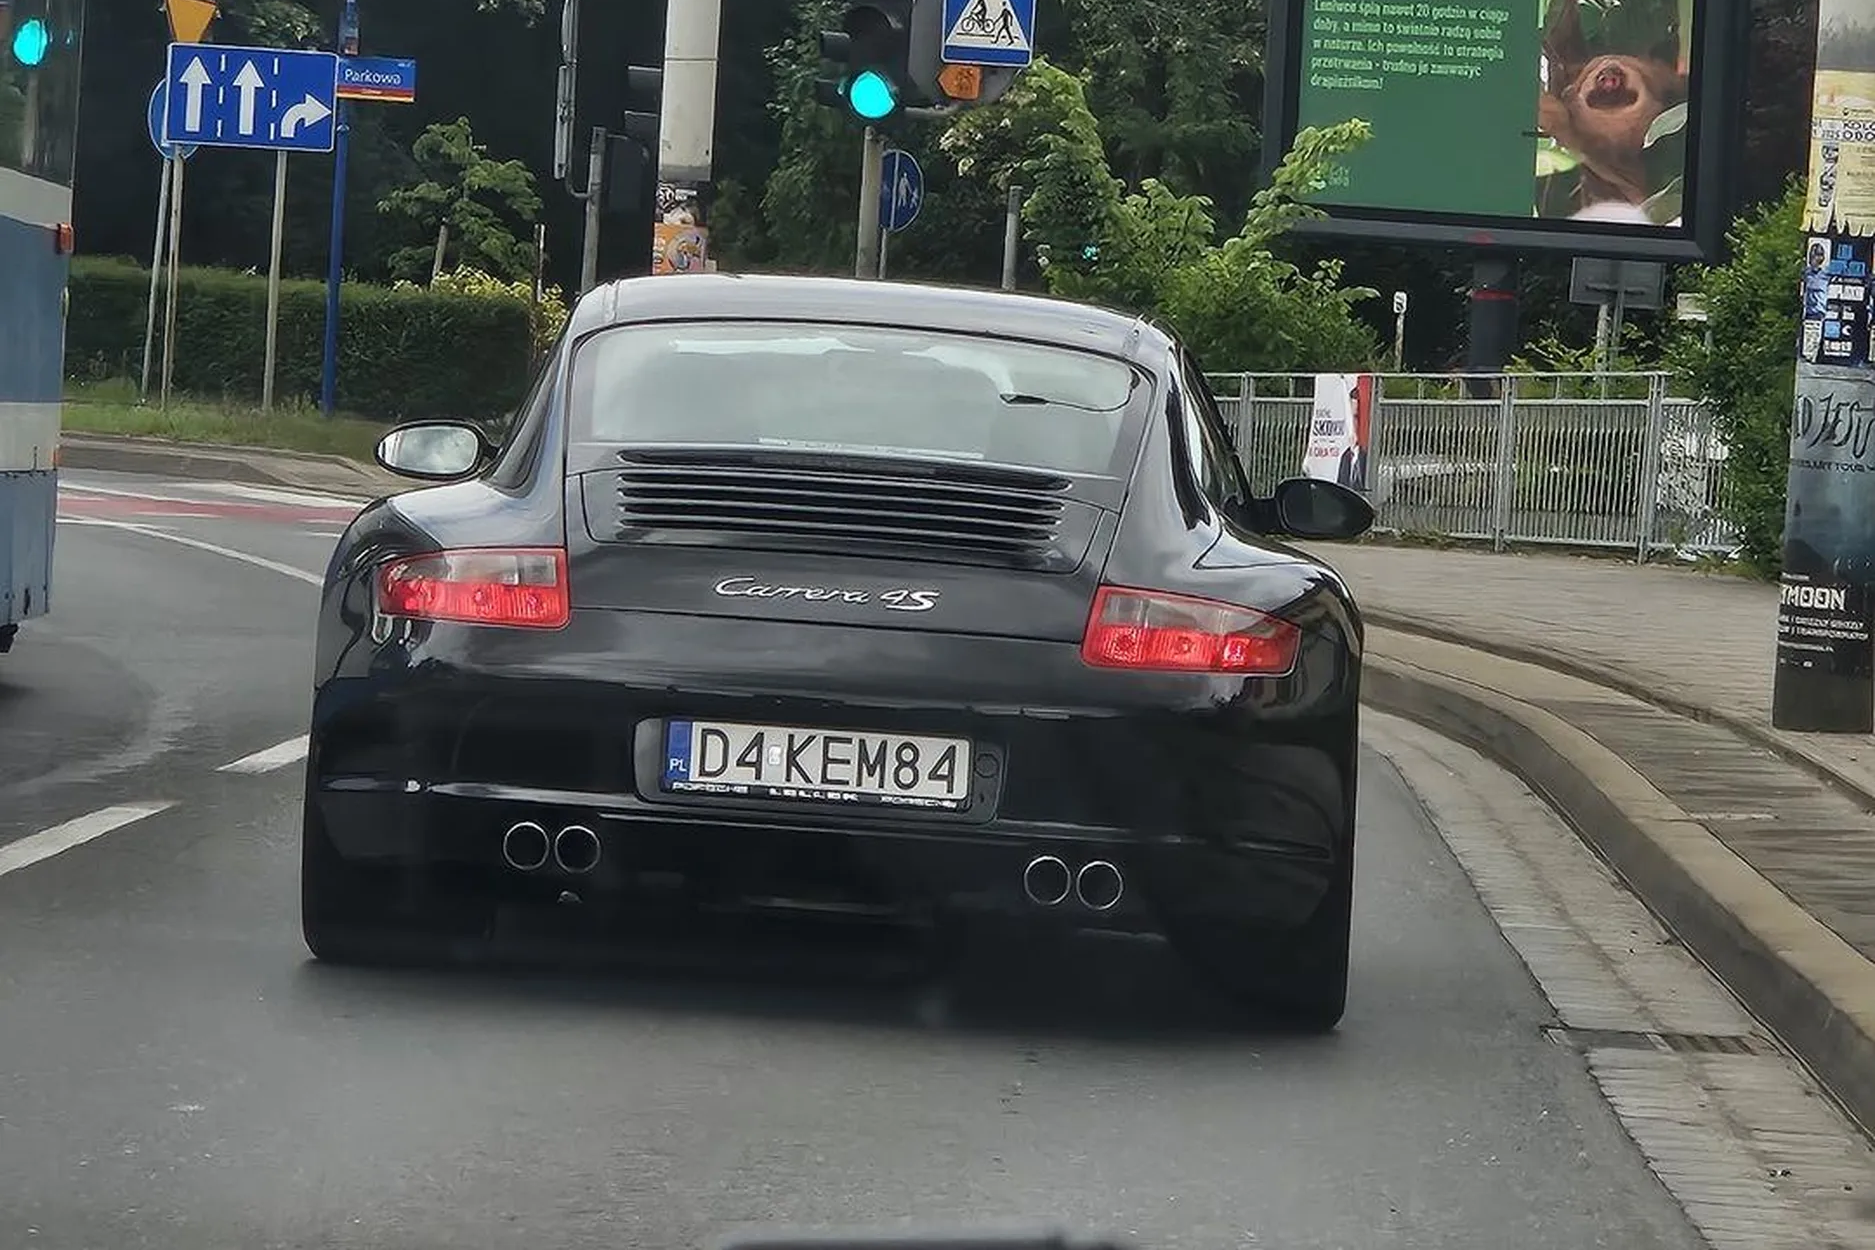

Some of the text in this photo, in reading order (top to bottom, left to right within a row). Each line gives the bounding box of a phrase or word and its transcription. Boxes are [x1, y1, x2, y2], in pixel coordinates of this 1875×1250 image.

[1416, 3, 1430, 18] 20
[1468, 9, 1478, 19] w
[1343, 21, 1350, 32] a
[1383, 21, 1395, 34] to
[1312, 39, 1321, 49] w
[1443, 44, 1454, 57] to
[344, 68, 402, 86] Parkowa
[715, 577, 940, 611] Carrera 4S
[669, 758, 687, 772] PL
[672, 781, 750, 795] PORSCHE
[880, 795, 958, 809] PORSCHE
